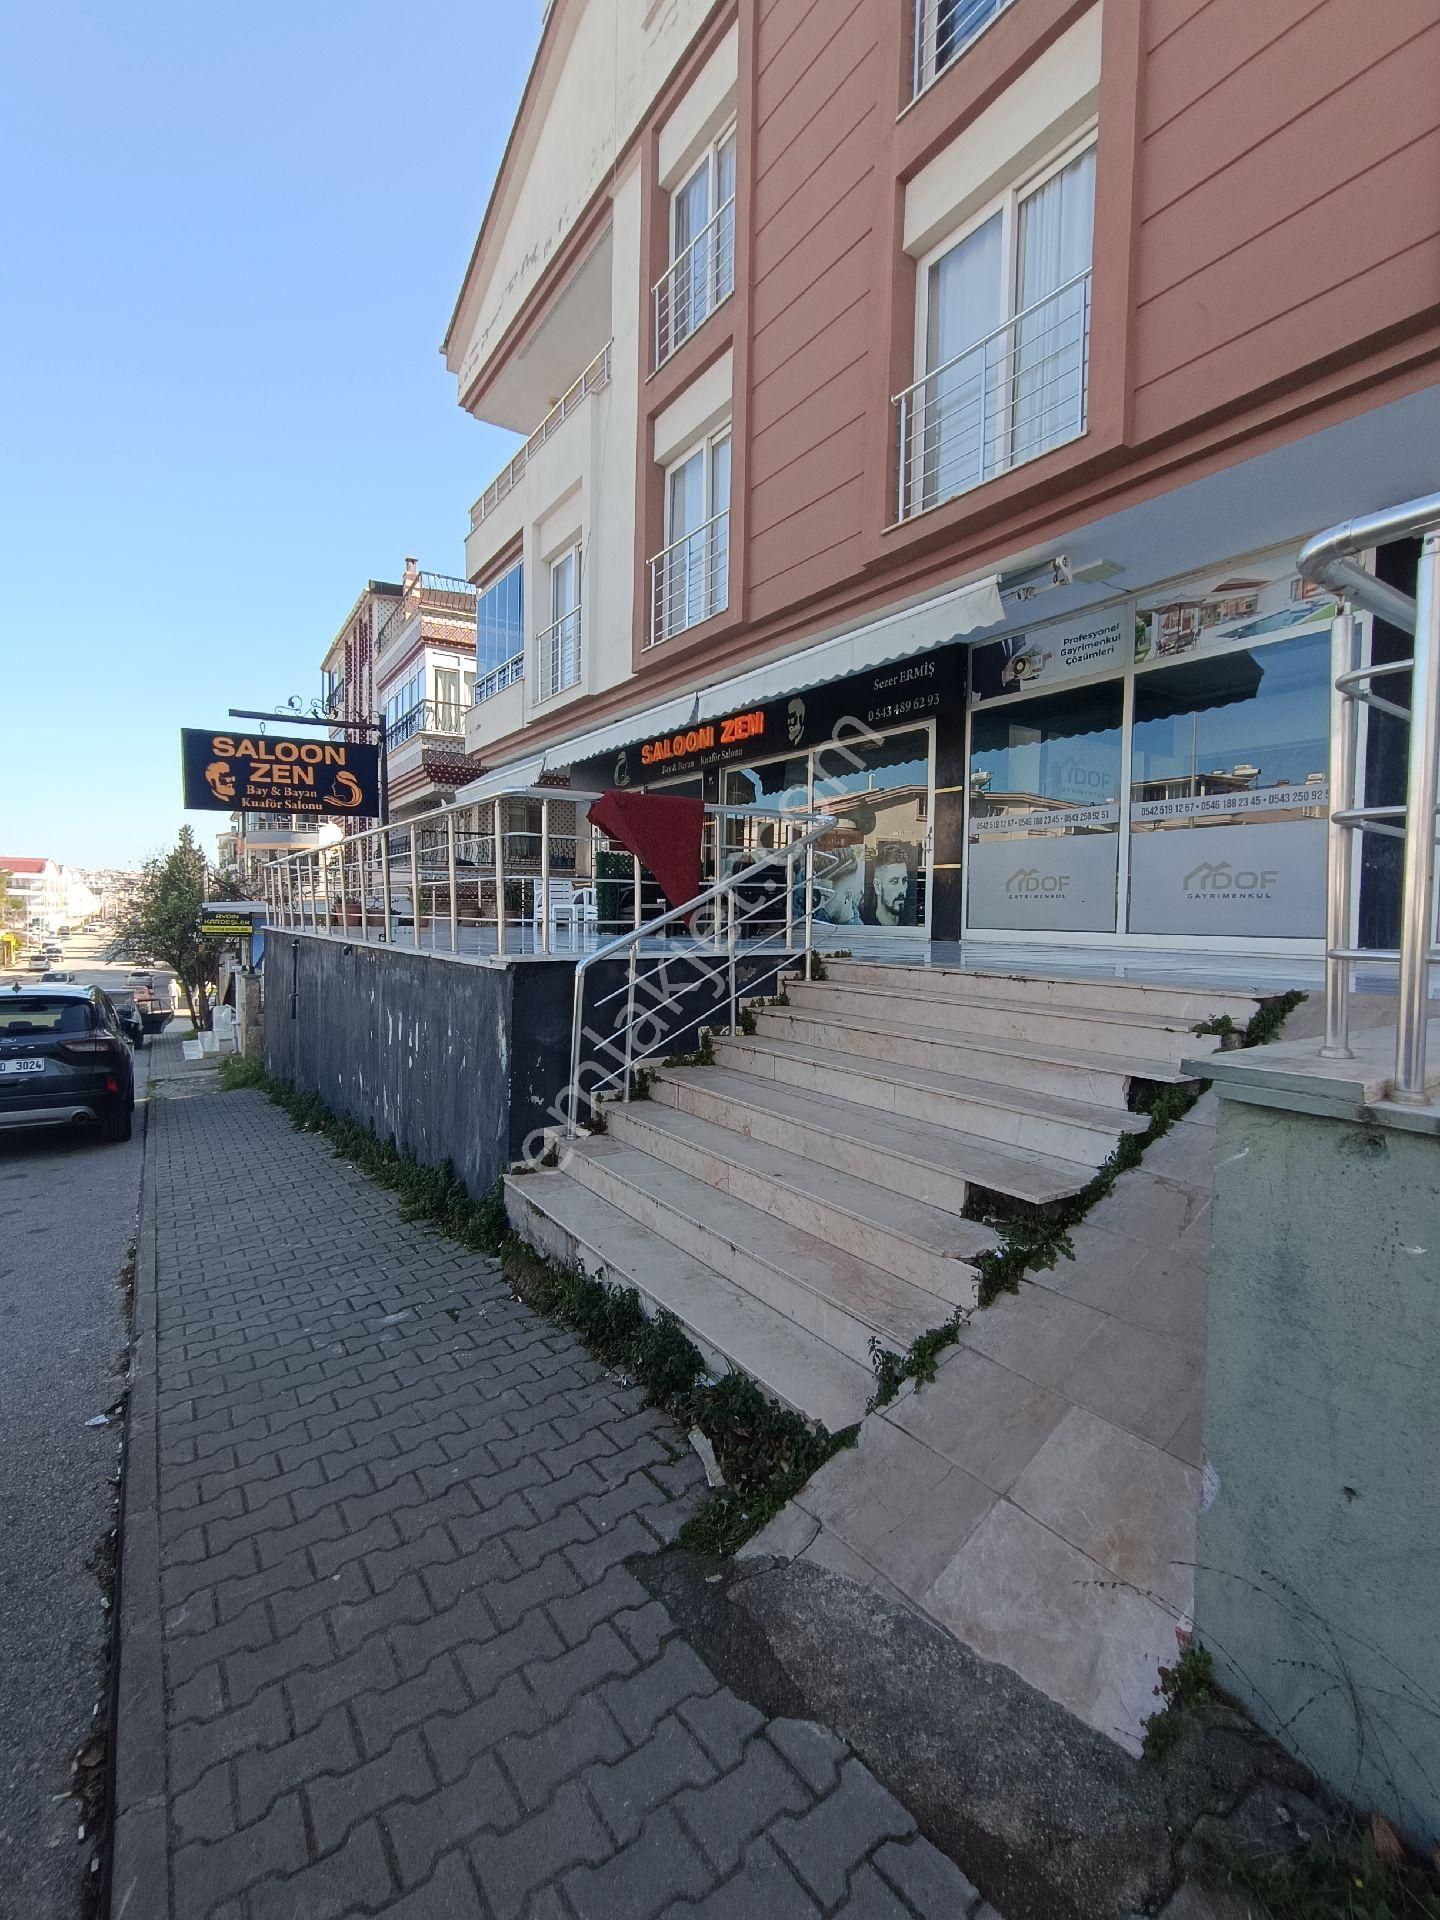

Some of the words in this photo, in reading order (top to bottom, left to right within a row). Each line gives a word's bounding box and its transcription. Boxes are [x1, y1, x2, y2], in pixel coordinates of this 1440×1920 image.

[1064, 622, 1119, 645] Profesyonel
[1061, 633, 1121, 656] Gayrimenkul
[1066, 645, 1114, 666] Çözümleri
[874, 676, 898, 690] Sezer
[900, 661, 935, 683] ERMİŞ
[894, 701, 911, 714] 489
[914, 698, 925, 709] 62
[928, 693, 939, 706] 93
[642, 726, 714, 765] SALOON
[721, 711, 764, 743] ZEN
[212, 736, 346, 765] SALOON
[700, 752, 720, 765] Kuaför
[722, 748, 742, 759] Salonu
[250, 762, 314, 785] ZEN
[247, 785, 268, 797] Bay
[271, 786, 281, 795] &
[284, 787, 317, 799] Bayan
[242, 798, 282, 808] Kuaför
[285, 800, 322, 809] Salonu
[1141, 807, 1158, 816] 0542
[1223, 799, 1236, 808] 188
[1239, 798, 1248, 806] 23
[1251, 796, 1261, 805] 45
[1269, 793, 1290, 804] 0543
[1293, 792, 1309, 802] 250
[1311, 790, 1322, 799] 92
[1102, 810, 1109, 819] 51
[1026, 876, 1070, 891] DOF
[1212, 871, 1279, 889] DOF
[16, 1061, 41, 1070] 3024
